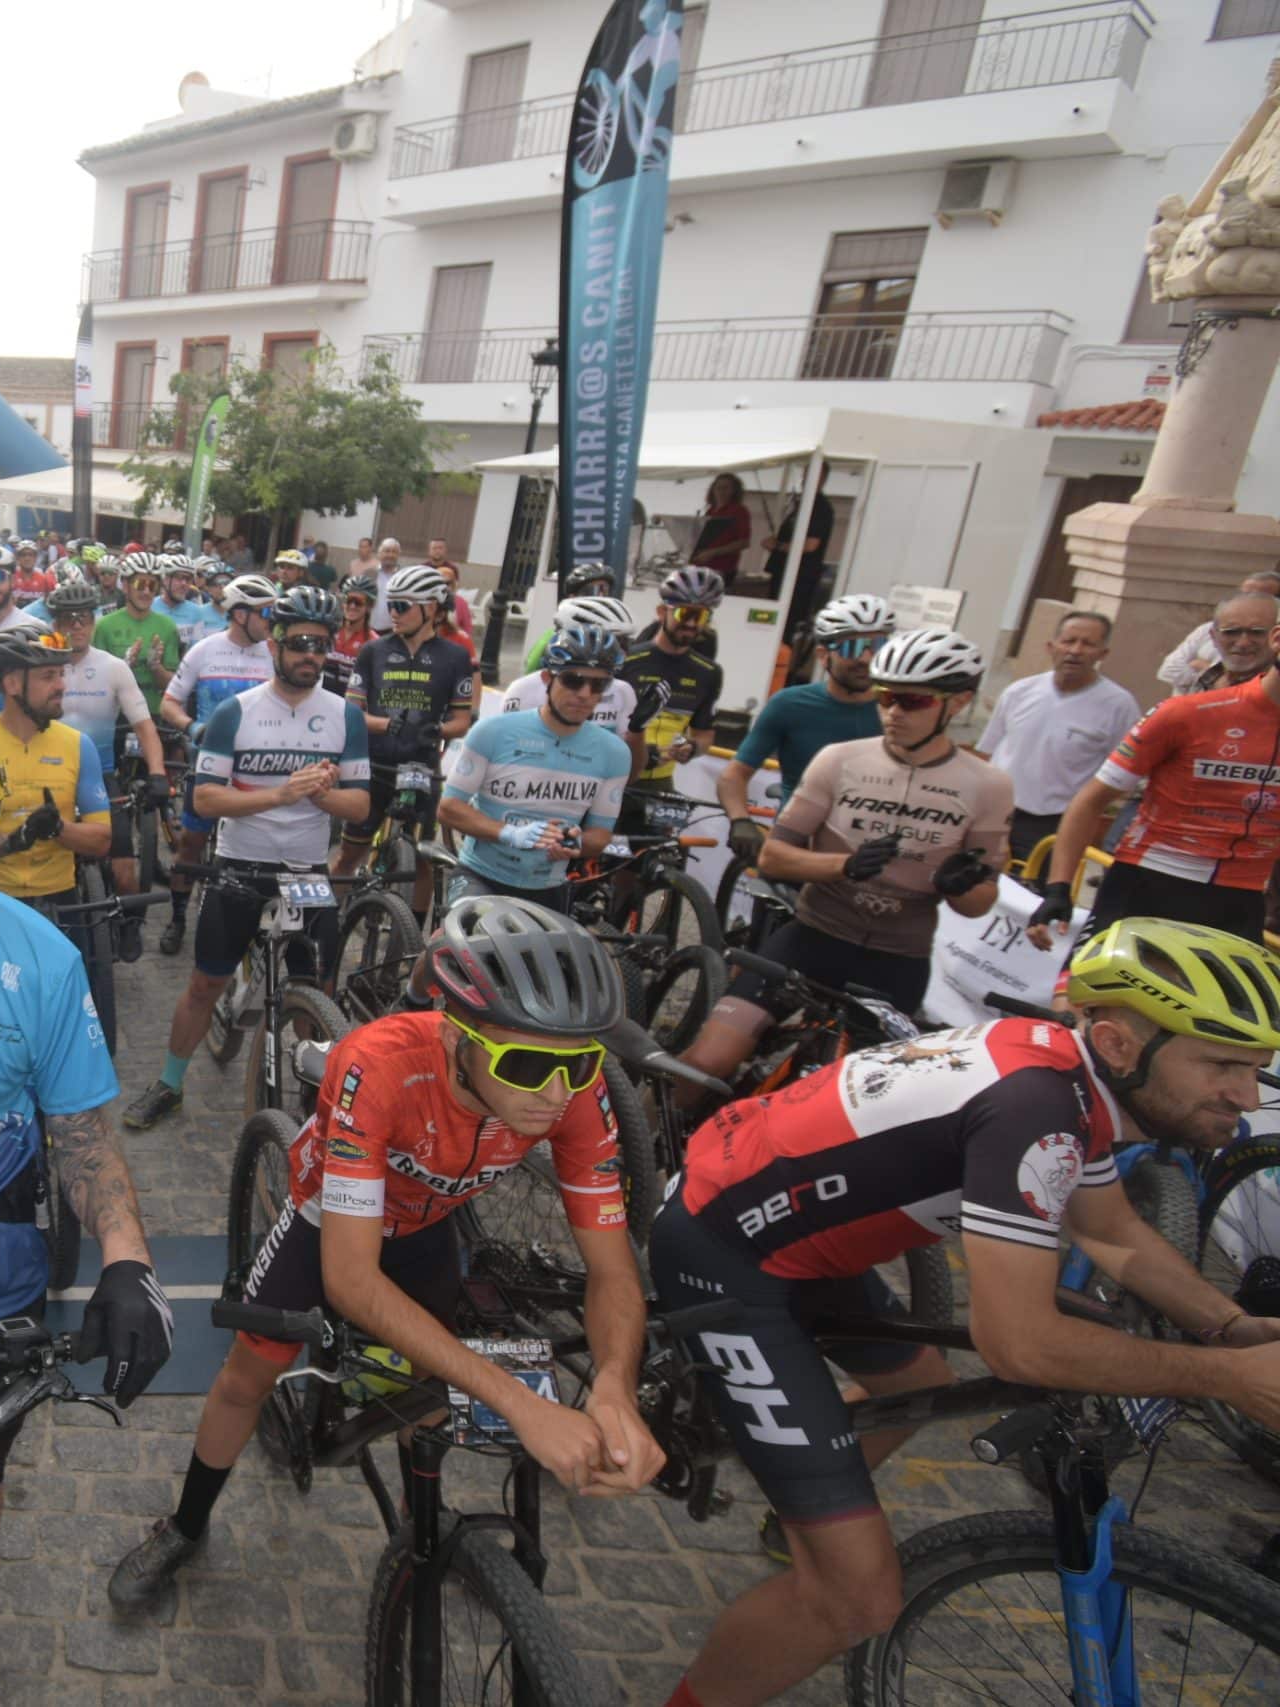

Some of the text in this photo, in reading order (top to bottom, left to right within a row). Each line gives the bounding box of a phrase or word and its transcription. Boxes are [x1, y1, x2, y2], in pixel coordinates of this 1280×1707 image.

[525, 781, 599, 801] MANILVA
[838, 794, 966, 826] HARMAN
[1116, 968, 1192, 1014] SCOTT
[736, 1172, 848, 1238] aero
[699, 1332, 810, 1446] BH
